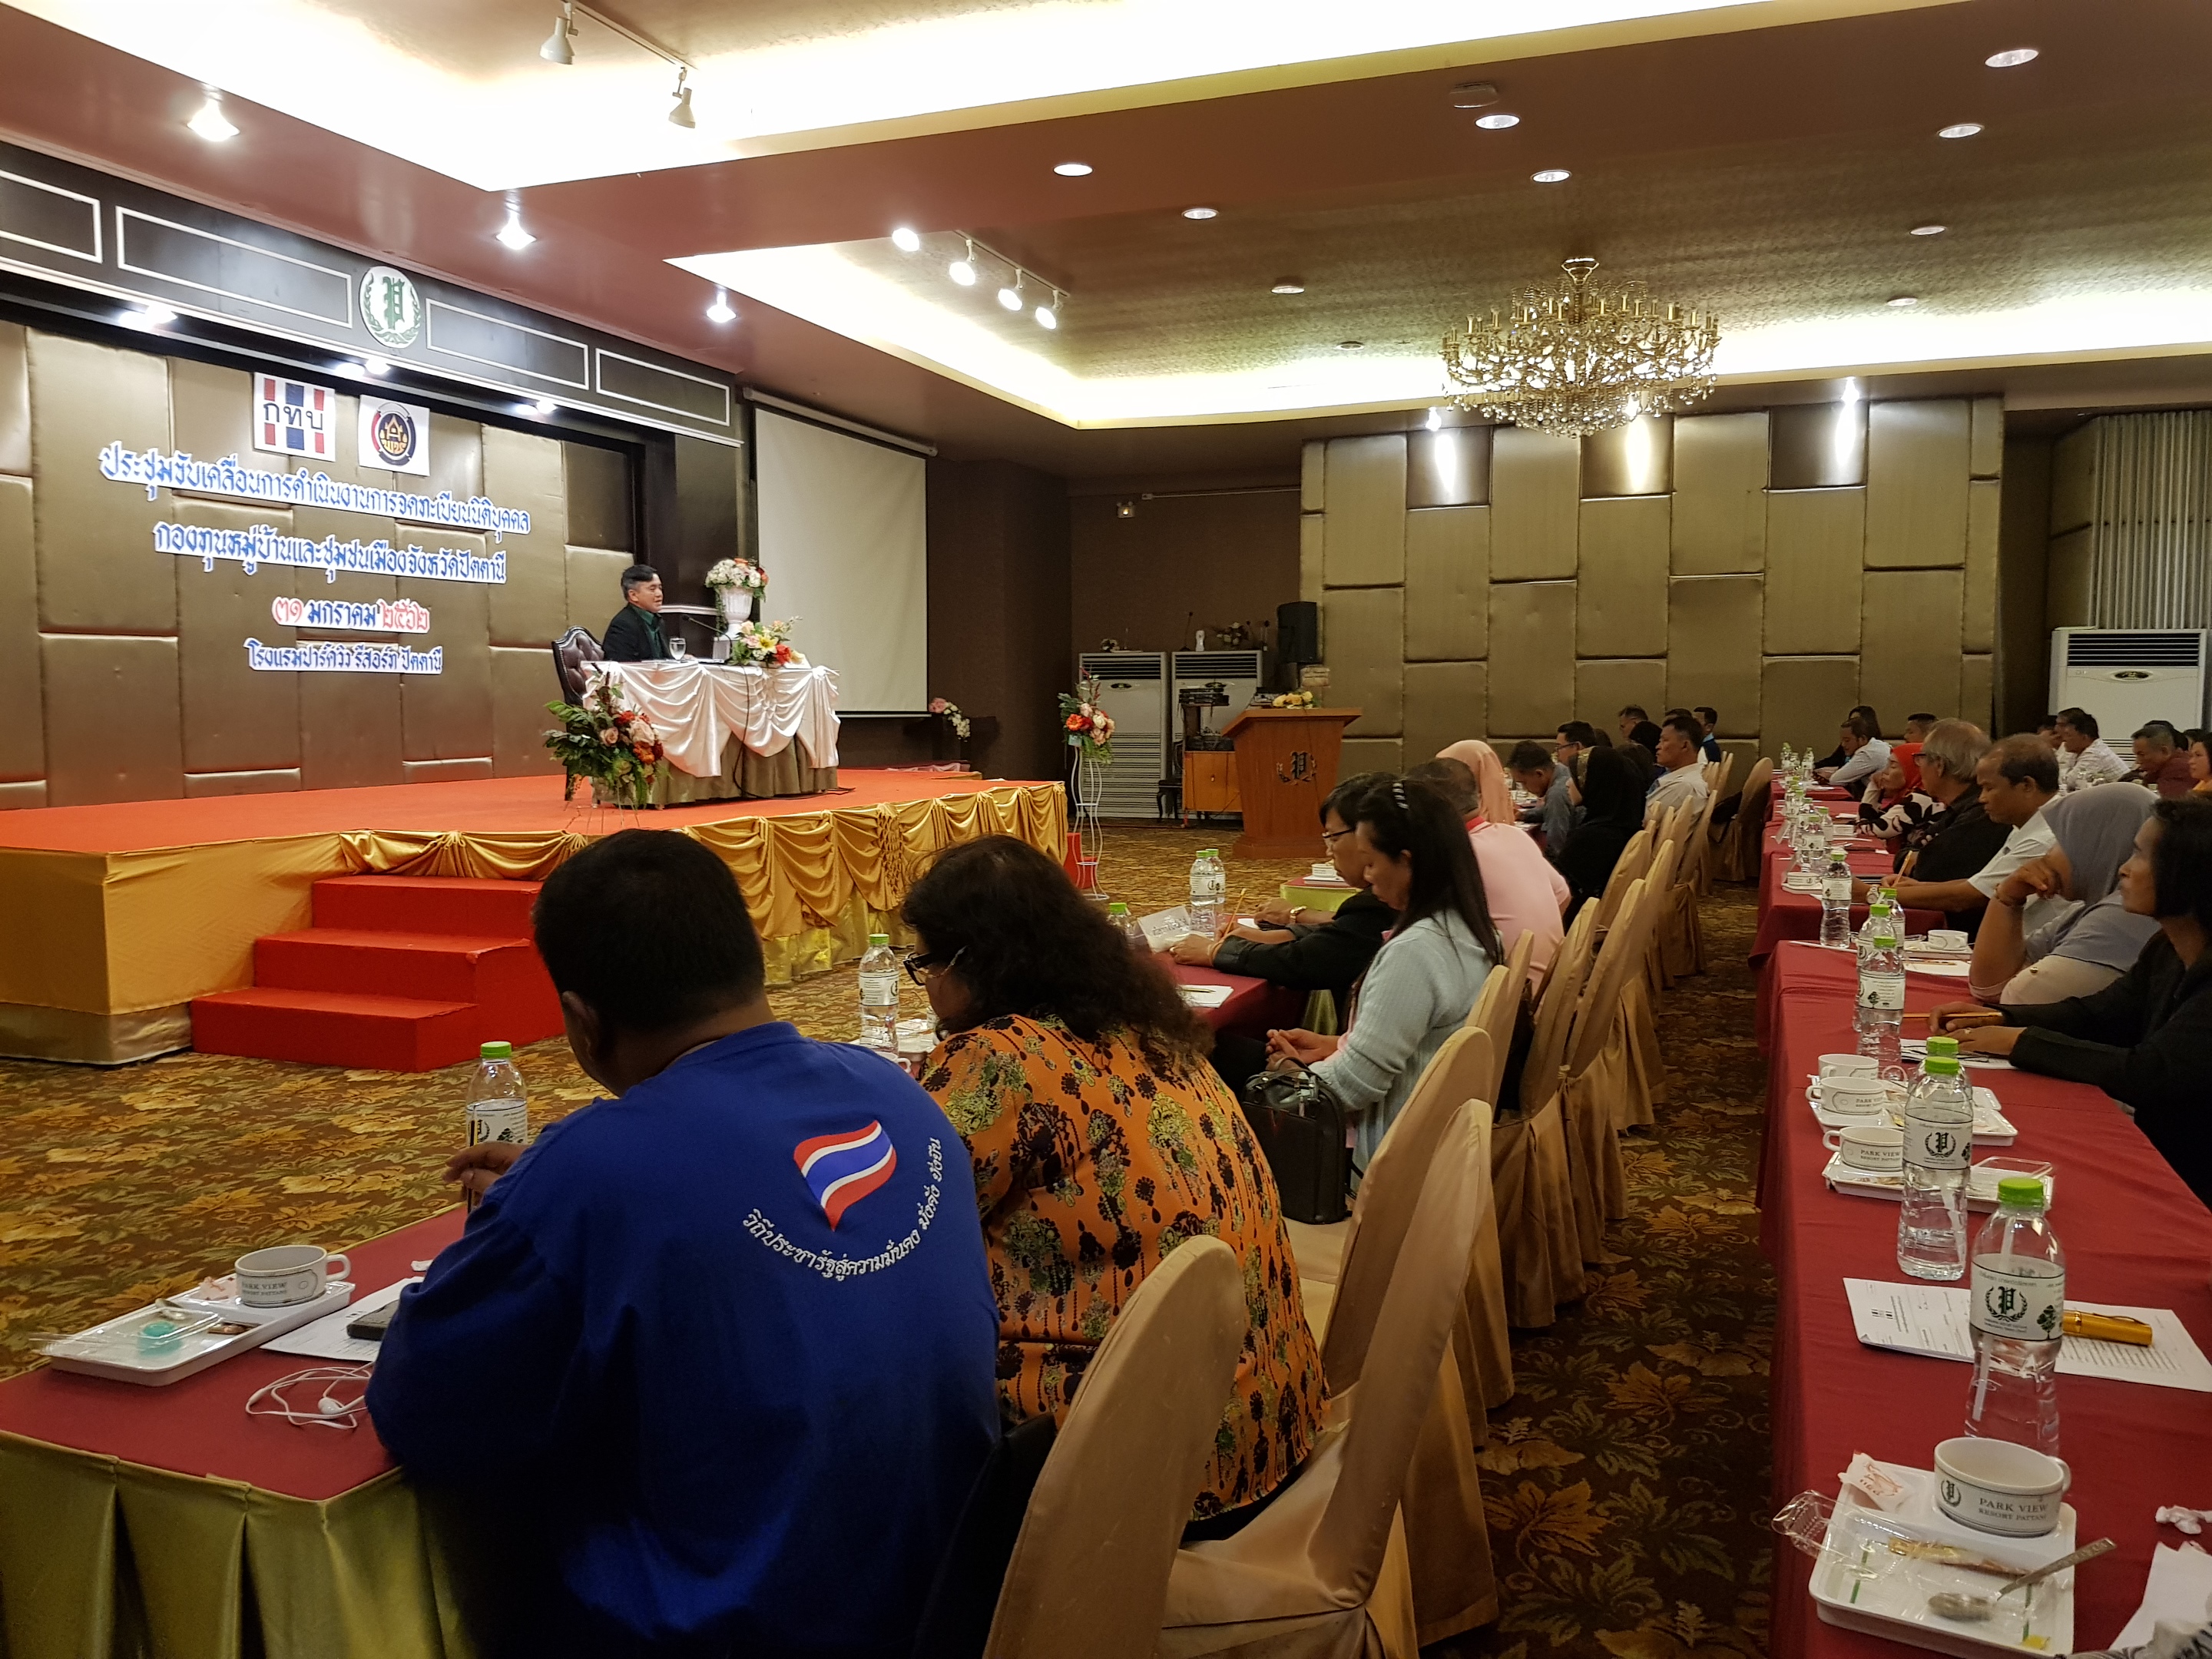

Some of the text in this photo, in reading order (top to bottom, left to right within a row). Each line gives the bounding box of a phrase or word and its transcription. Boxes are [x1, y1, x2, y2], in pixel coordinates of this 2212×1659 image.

[263, 402, 323, 431] กทบ
[156, 524, 506, 582] กองทุนหมู่บ้านและชุมชนเมืองจังหวัดปัตตานี
[275, 599, 429, 631] ๓๑ มกราคม ๒๕๖๒
[401, 647, 443, 671] ปัตตานี
[743, 1137, 943, 1281] วิถีประชารัฐสู่ความมั่นคง มั่งคั่ง ยั่งยืน
[1979, 1498, 2048, 1513] PARK VIEW
